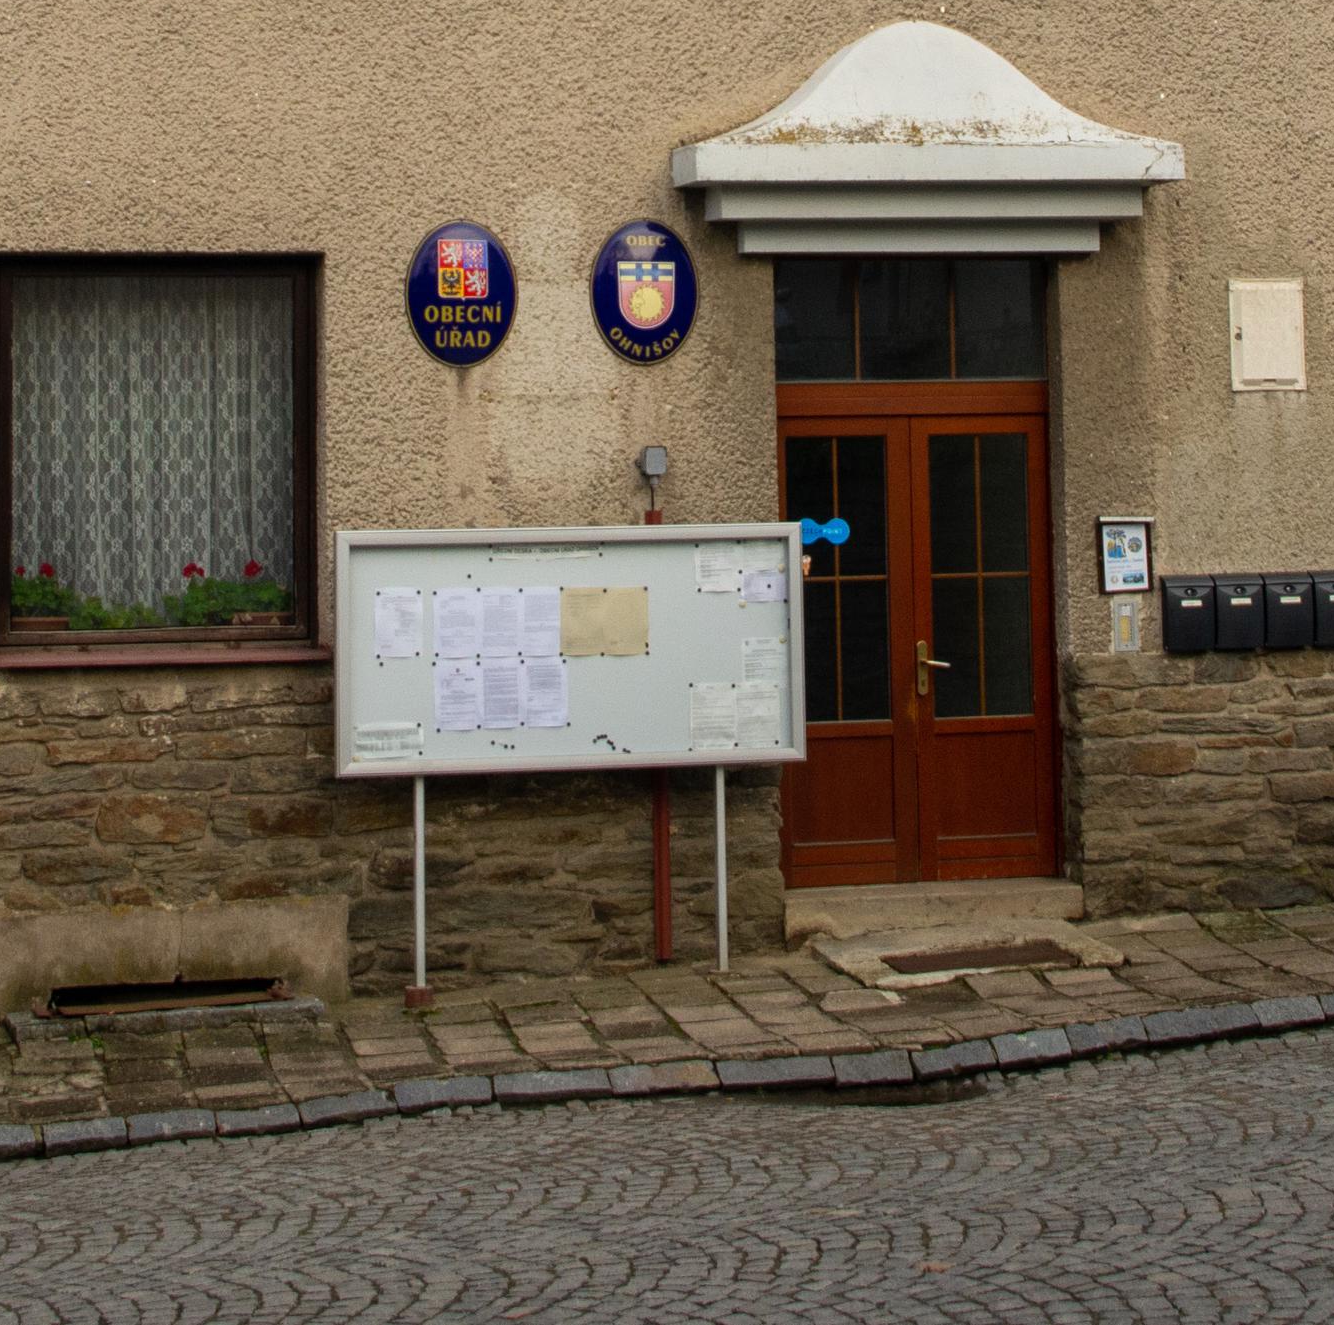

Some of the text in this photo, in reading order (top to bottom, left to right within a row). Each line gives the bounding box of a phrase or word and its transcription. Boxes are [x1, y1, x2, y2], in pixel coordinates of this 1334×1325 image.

[626, 235, 666, 247] OBEC
[424, 301, 502, 324] OBECNÍ
[435, 325, 492, 349] ÚŘAD
[609, 327, 680, 357] OHNIŠOV
